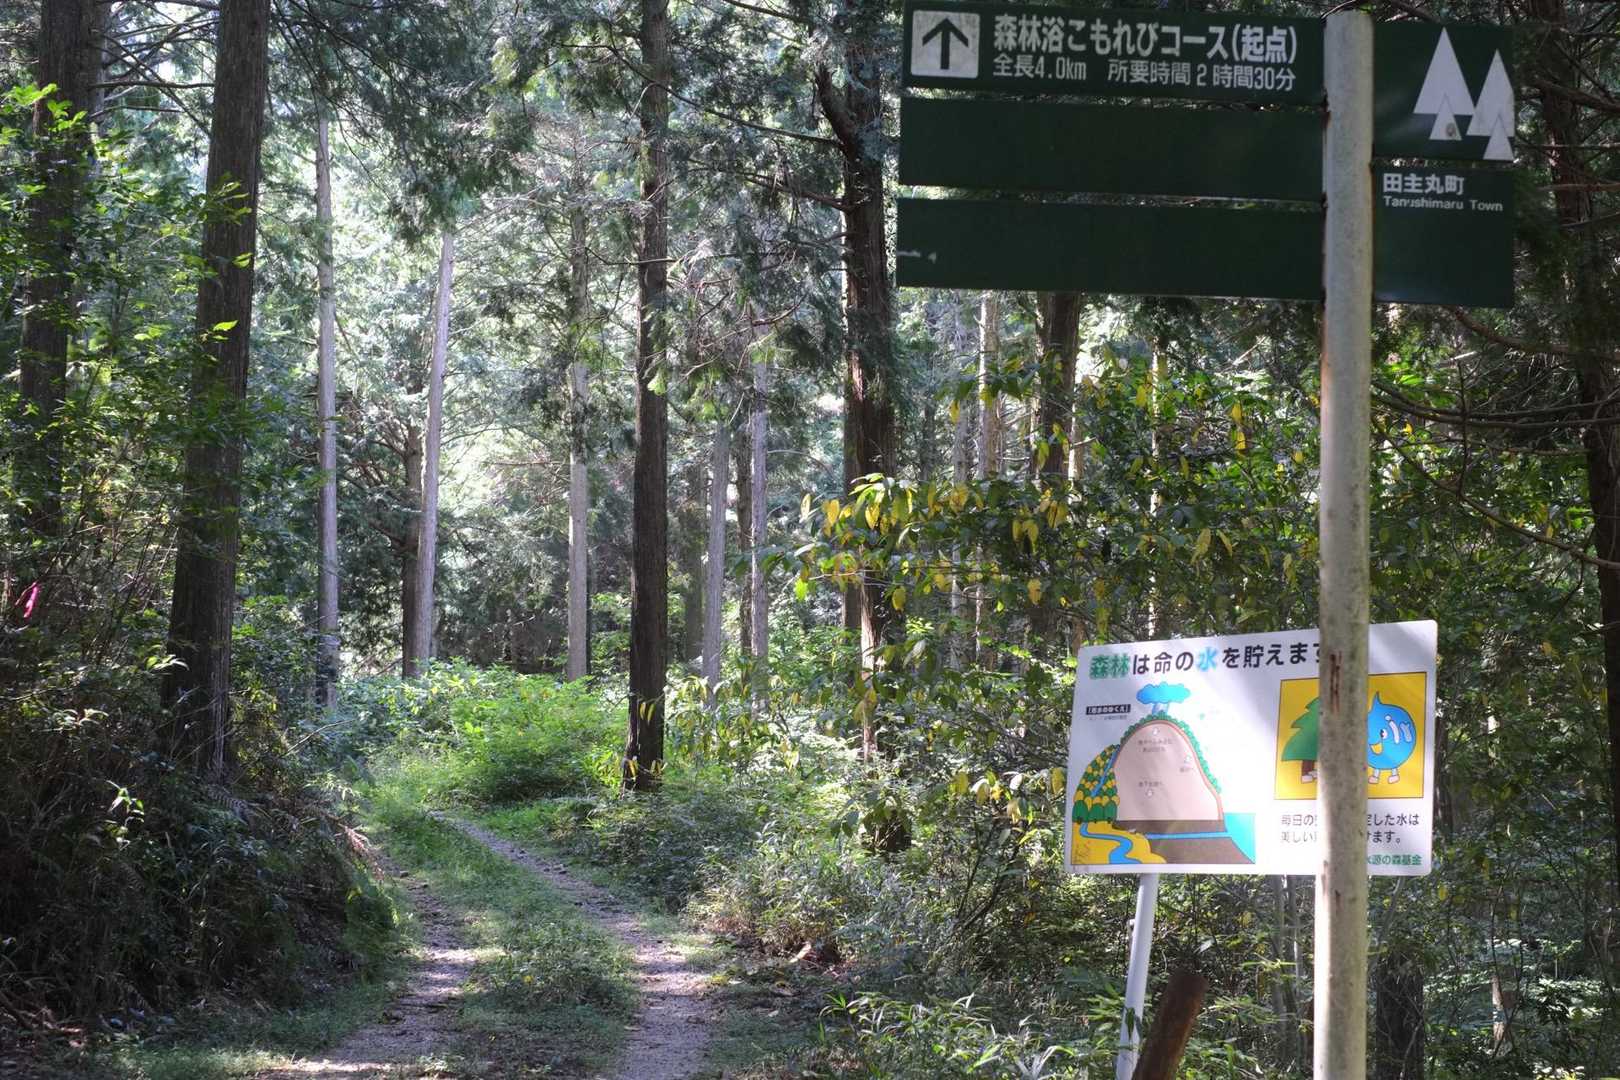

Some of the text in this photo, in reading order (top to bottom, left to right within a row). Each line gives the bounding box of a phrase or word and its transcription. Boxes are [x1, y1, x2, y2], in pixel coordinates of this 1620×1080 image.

[993, 13, 1297, 64] 森林浴こもれびコース(起点)
[992, 52, 1087, 81] 全長4.0km
[1383, 172, 1465, 195] 田主丸町
[1470, 199, 1503, 212] Town
[1281, 814, 1317, 827] 毎日の
